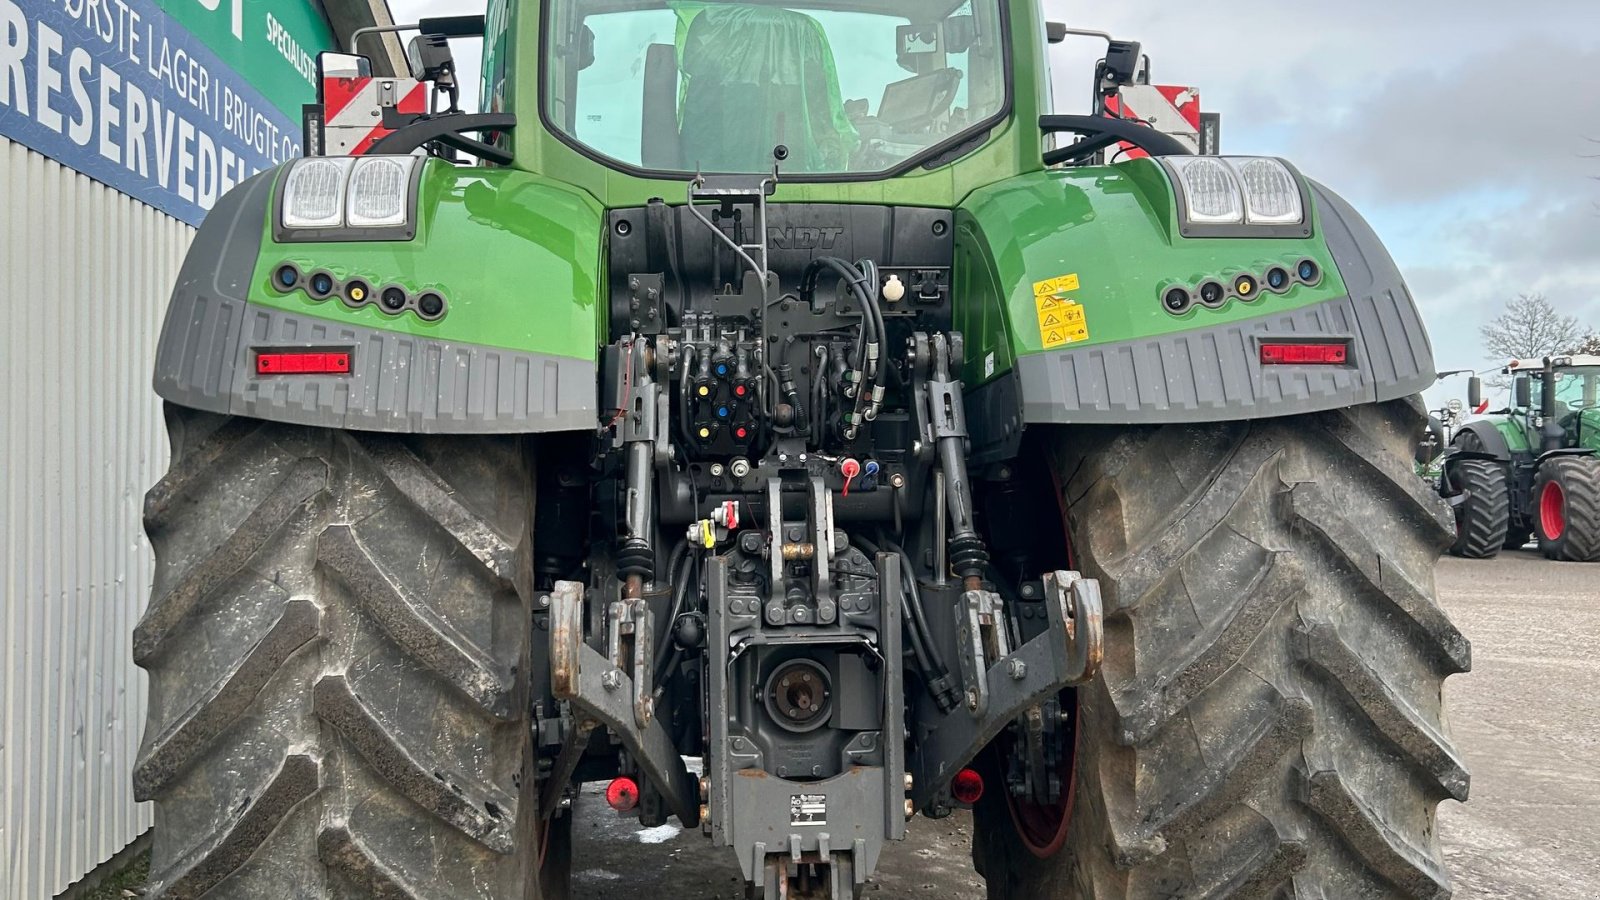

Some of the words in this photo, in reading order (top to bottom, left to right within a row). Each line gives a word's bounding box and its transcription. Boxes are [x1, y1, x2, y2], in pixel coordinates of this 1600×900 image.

[148, 24, 210, 116] LAGER
[214, 79, 219, 121] I
[224, 85, 279, 165] BRUGTE
[722, 226, 845, 250] NDT
